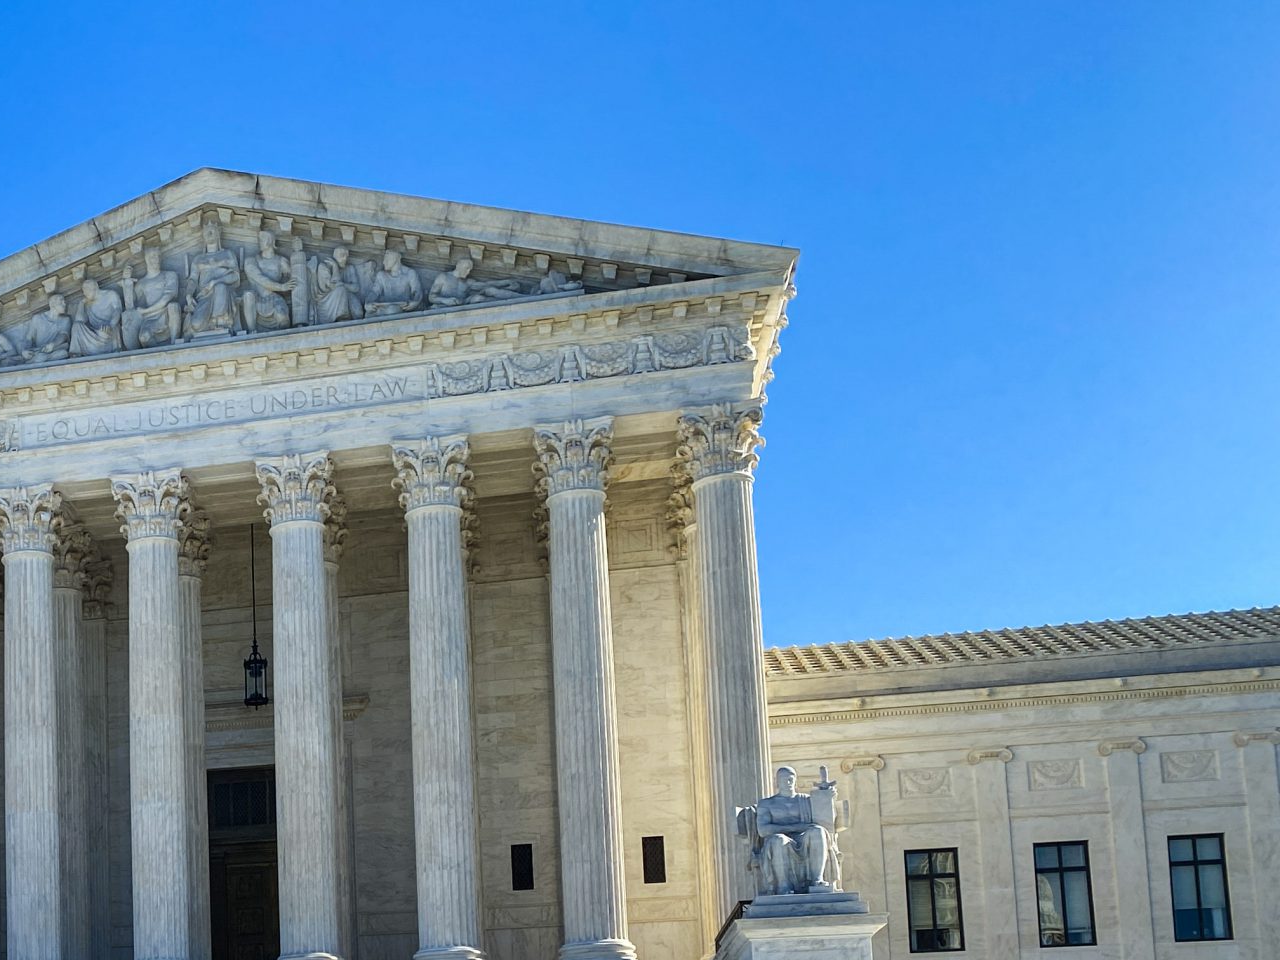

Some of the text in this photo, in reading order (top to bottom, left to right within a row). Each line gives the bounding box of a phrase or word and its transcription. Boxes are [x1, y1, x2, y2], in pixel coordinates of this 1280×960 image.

[36, 376, 408, 442] EQUAL JUSTICE UNDER LAW
